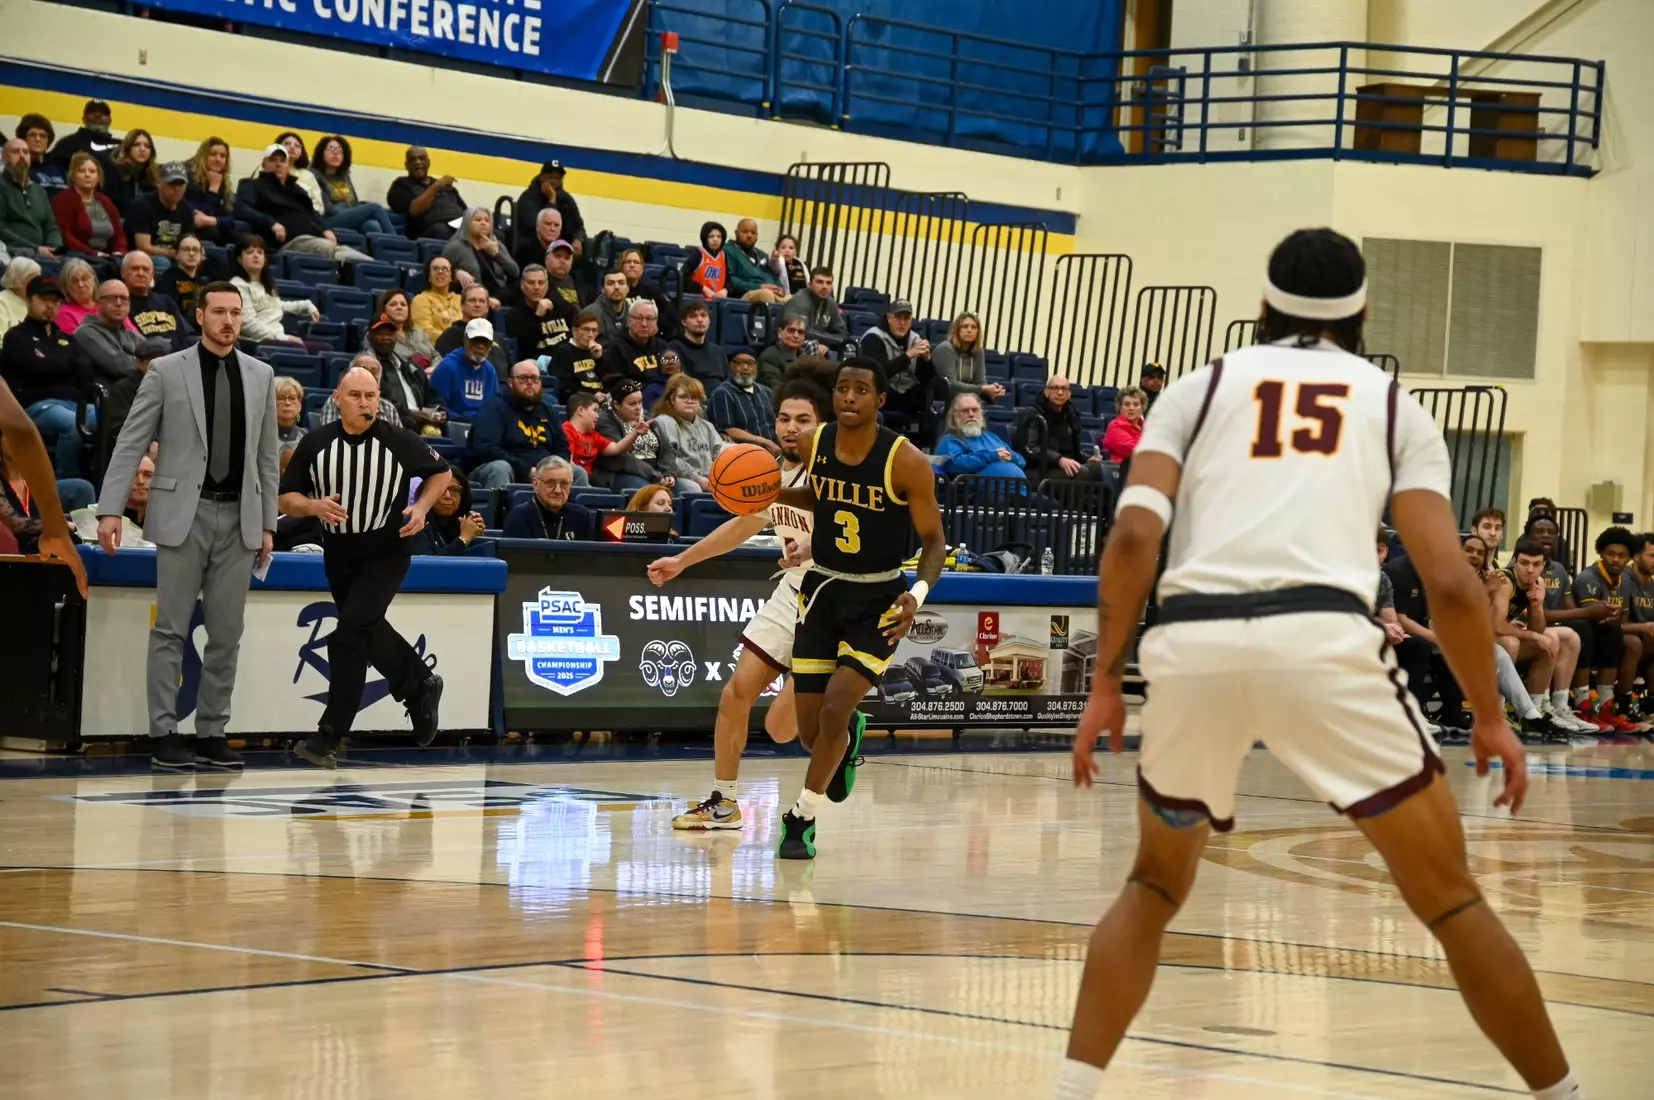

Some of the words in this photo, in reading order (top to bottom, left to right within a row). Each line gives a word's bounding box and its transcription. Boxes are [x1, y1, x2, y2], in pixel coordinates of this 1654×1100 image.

[1250, 379, 1351, 459] 15
[810, 474, 885, 512] VILLE
[625, 522, 646, 534] POSS.
[834, 510, 861, 554] 3
[541, 600, 582, 613] PSAC
[552, 626, 575, 634] MEN'S
[516, 640, 612, 655] BASKETBALL
[557, 672, 574, 680] 2025
[911, 701, 964, 711] 304.876.2500
[976, 701, 1028, 711] 304.876.7000
[1047, 701, 1087, 711] 304.876.31
